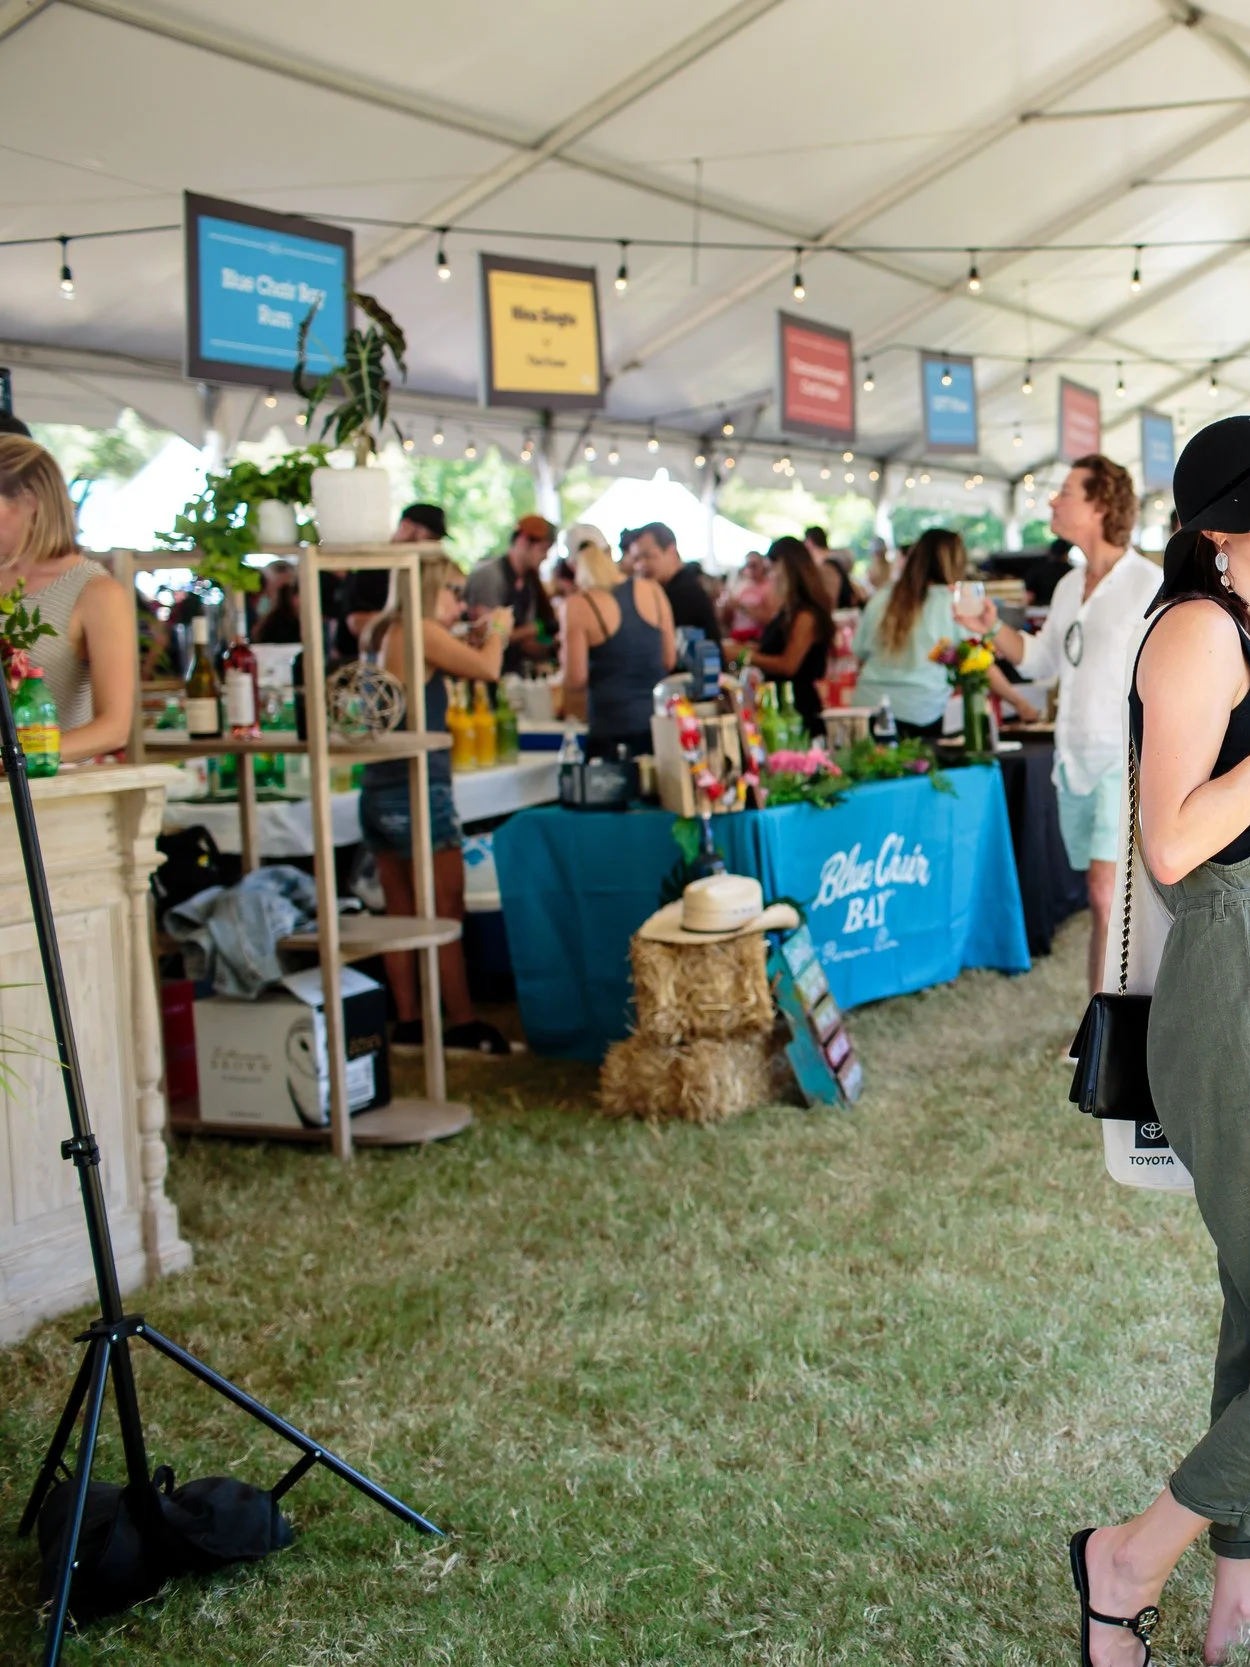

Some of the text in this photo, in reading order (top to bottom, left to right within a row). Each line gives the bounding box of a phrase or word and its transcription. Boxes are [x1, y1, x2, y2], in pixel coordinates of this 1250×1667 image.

[811, 832, 931, 911] Blue Chair
[842, 889, 896, 934] BAY
[1129, 1156, 1175, 1166] TOYOTA
